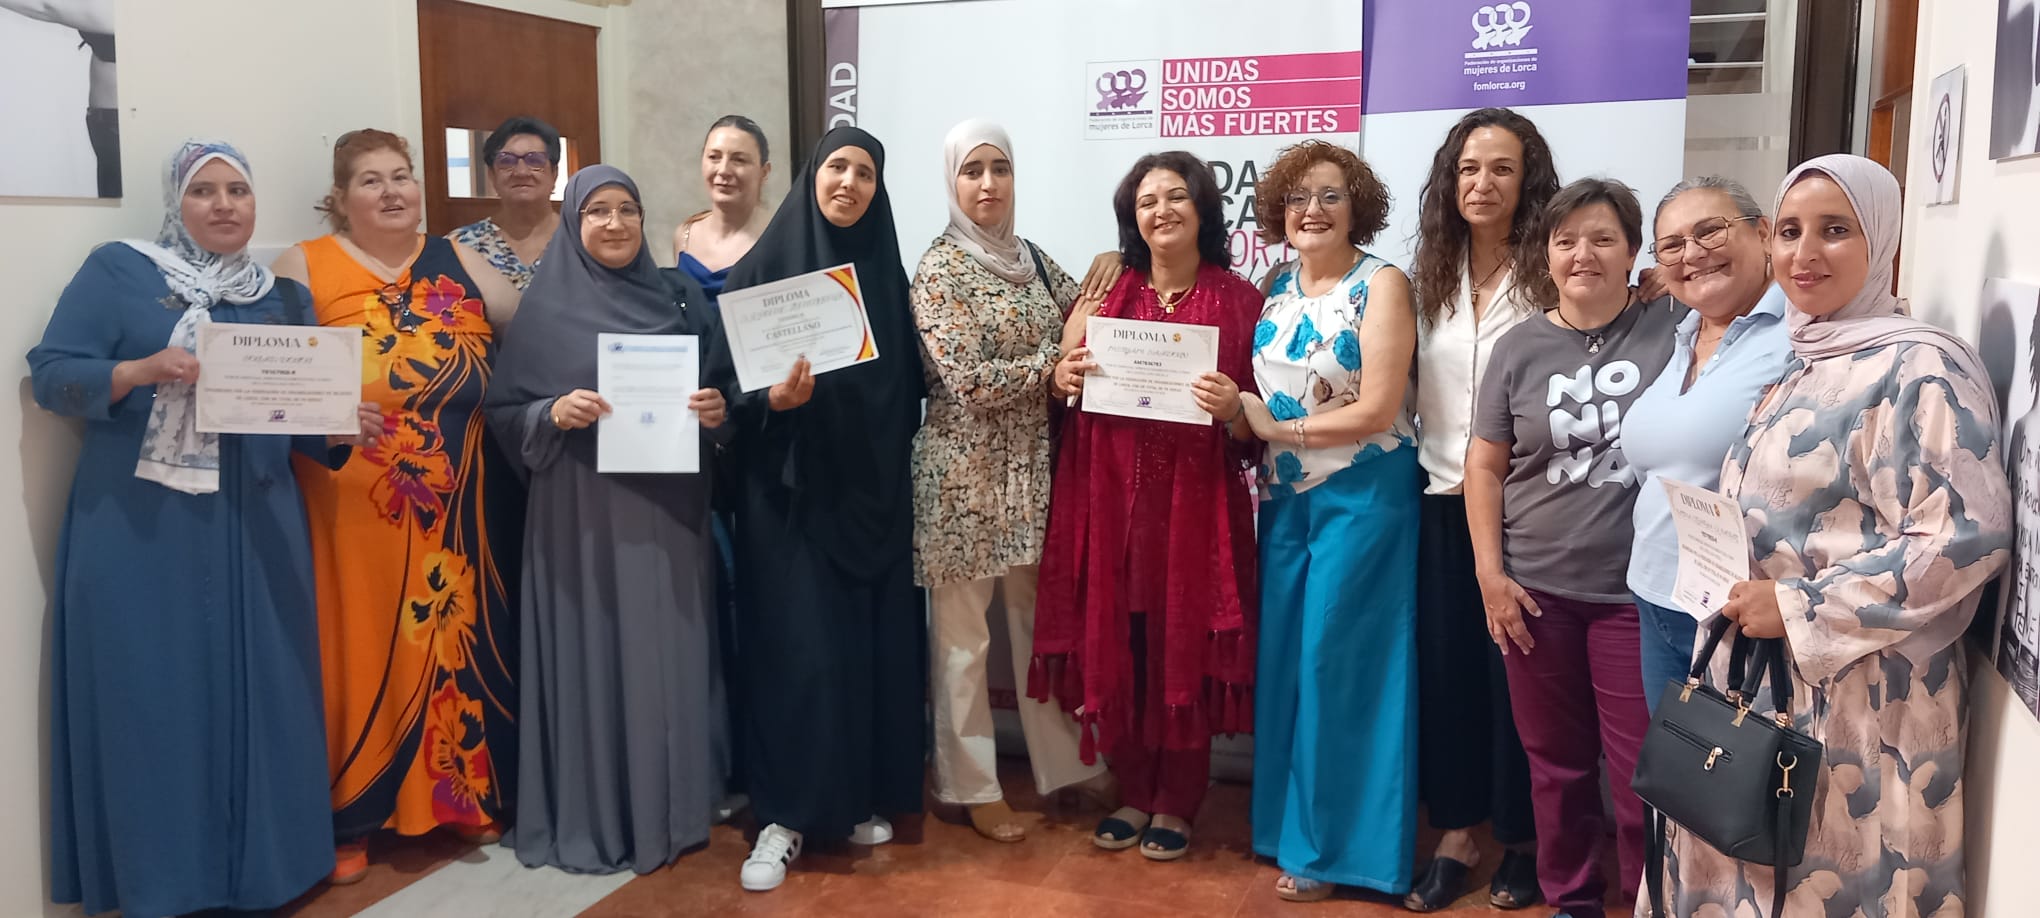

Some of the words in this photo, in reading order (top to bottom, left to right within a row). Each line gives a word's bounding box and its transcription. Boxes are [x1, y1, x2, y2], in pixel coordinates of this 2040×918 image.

[1164, 59, 1259, 83] UNIDAS
[1464, 65, 1498, 76] mujeres
[1500, 64, 1511, 73] de
[1512, 63, 1537, 72] Lorca
[1163, 86, 1252, 110] SOMOS
[1473, 81, 1526, 91] fomlorca.org
[1162, 108, 1216, 136] MÁS
[1224, 109, 1339, 135] FUERTES
[762, 288, 810, 308] DIPLOMA
[232, 335, 302, 348] DIPLOMA
[766, 321, 821, 340] CASTELLANO
[1113, 328, 1168, 343] DIPLOMA
[1546, 360, 1641, 407] NO
[1549, 400, 1620, 449] NI
[1546, 438, 1637, 488] NA
[1680, 492, 1715, 517] DIPLOMA
